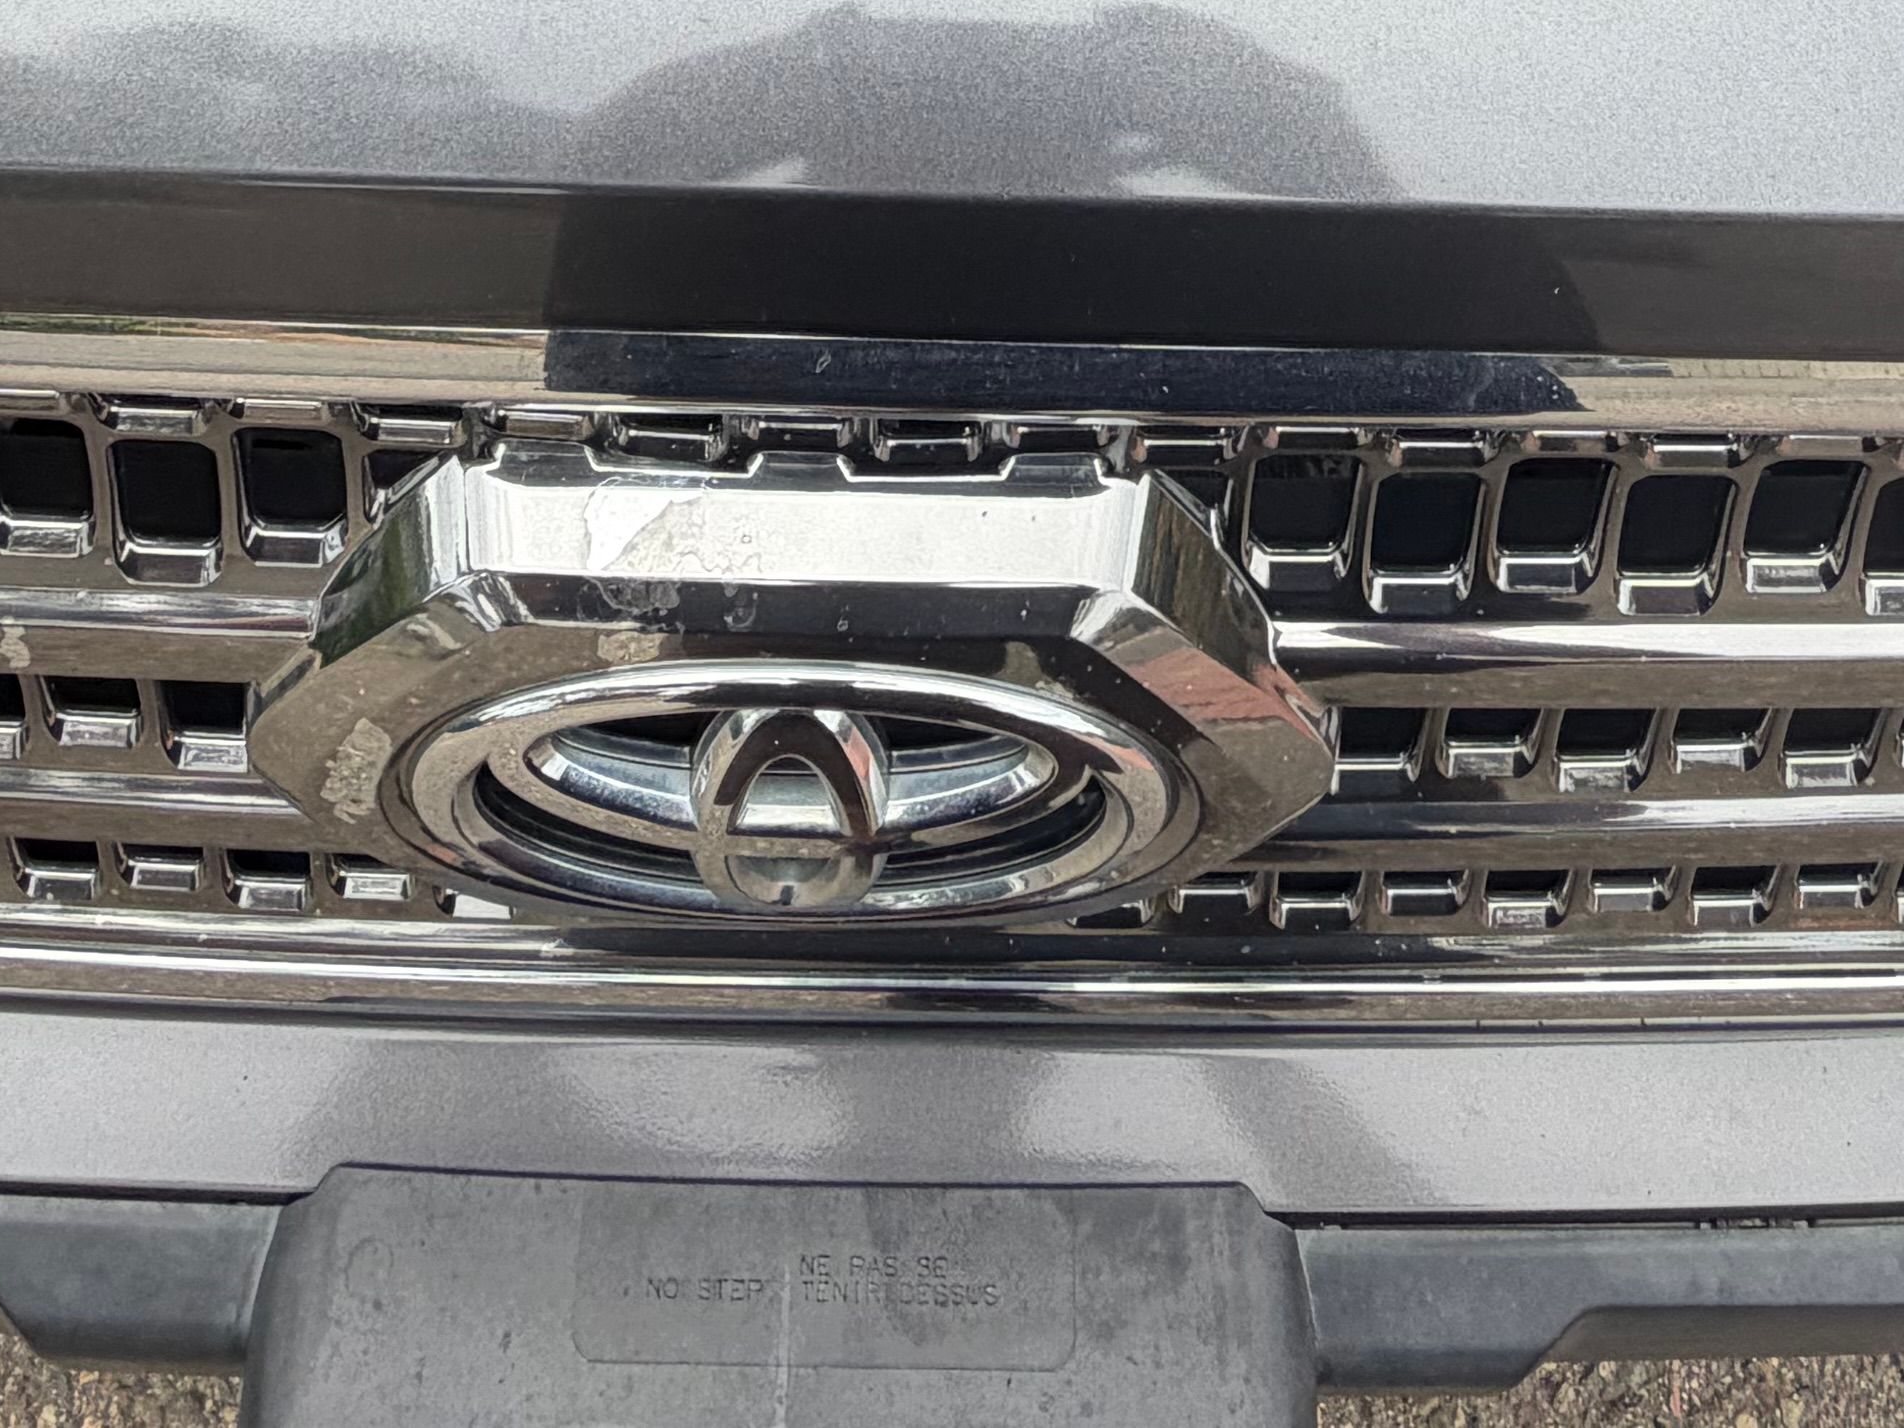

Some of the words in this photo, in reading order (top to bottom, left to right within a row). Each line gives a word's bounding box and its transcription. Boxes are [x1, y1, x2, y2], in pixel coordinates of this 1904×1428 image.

[800, 1254, 830, 1277] NE
[646, 1276, 678, 1300] NO
[697, 1277, 765, 1301] STEP
